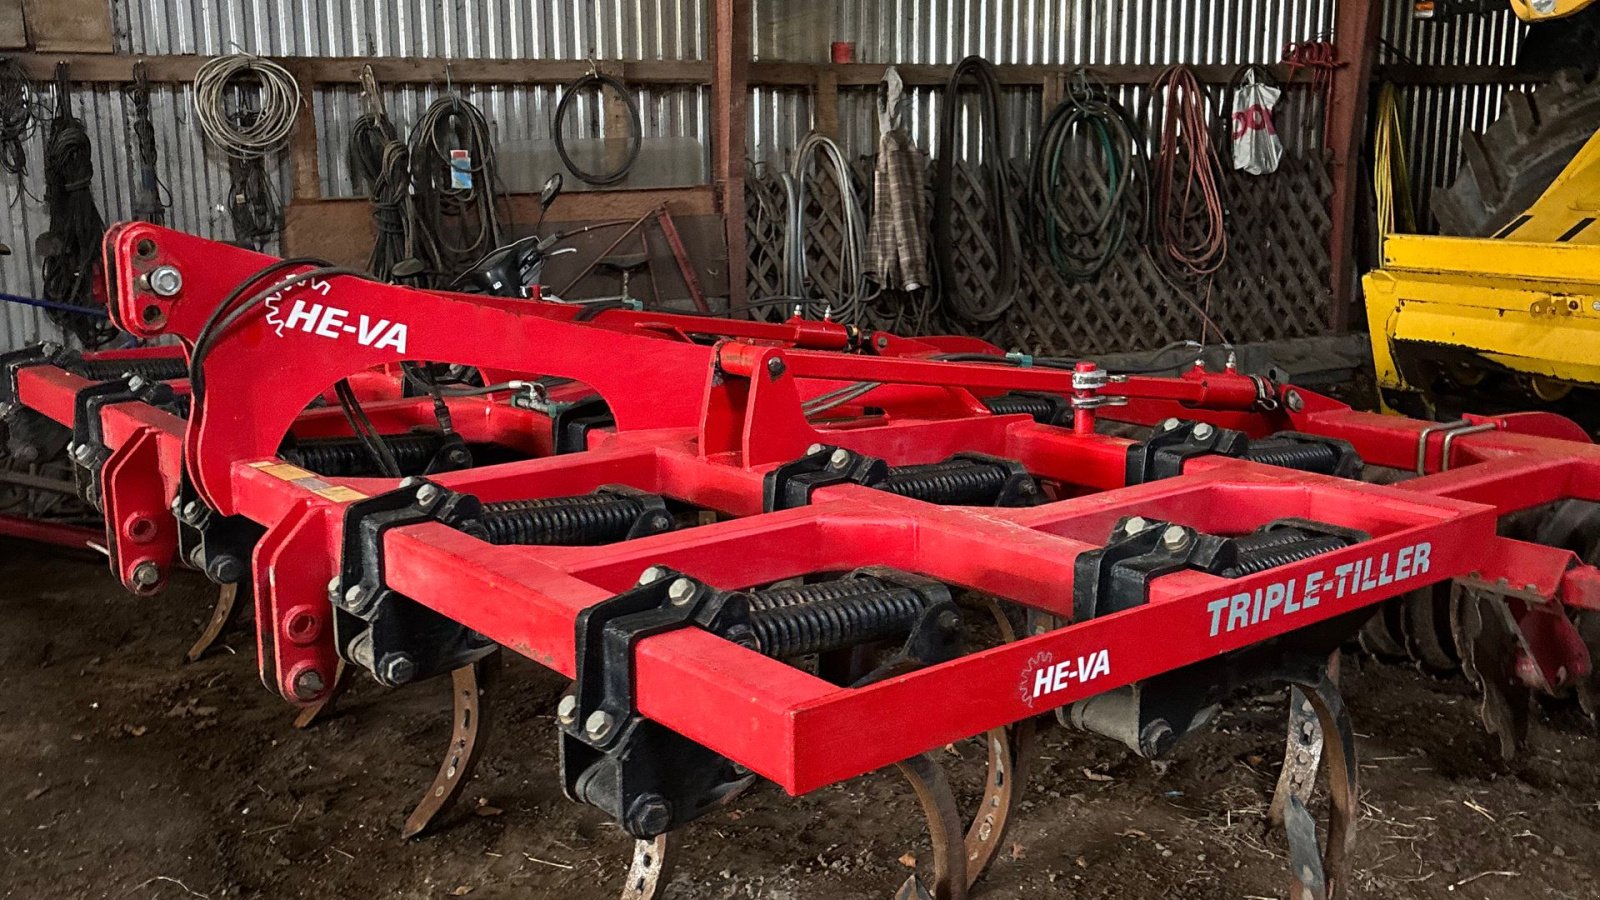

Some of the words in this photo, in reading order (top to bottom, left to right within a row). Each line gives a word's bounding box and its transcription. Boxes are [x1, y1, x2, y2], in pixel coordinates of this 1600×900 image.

[285, 299, 407, 354] HE-VA
[1207, 542, 1431, 637] TRIPLE-TILLER
[1033, 649, 1110, 698] HE-VA
